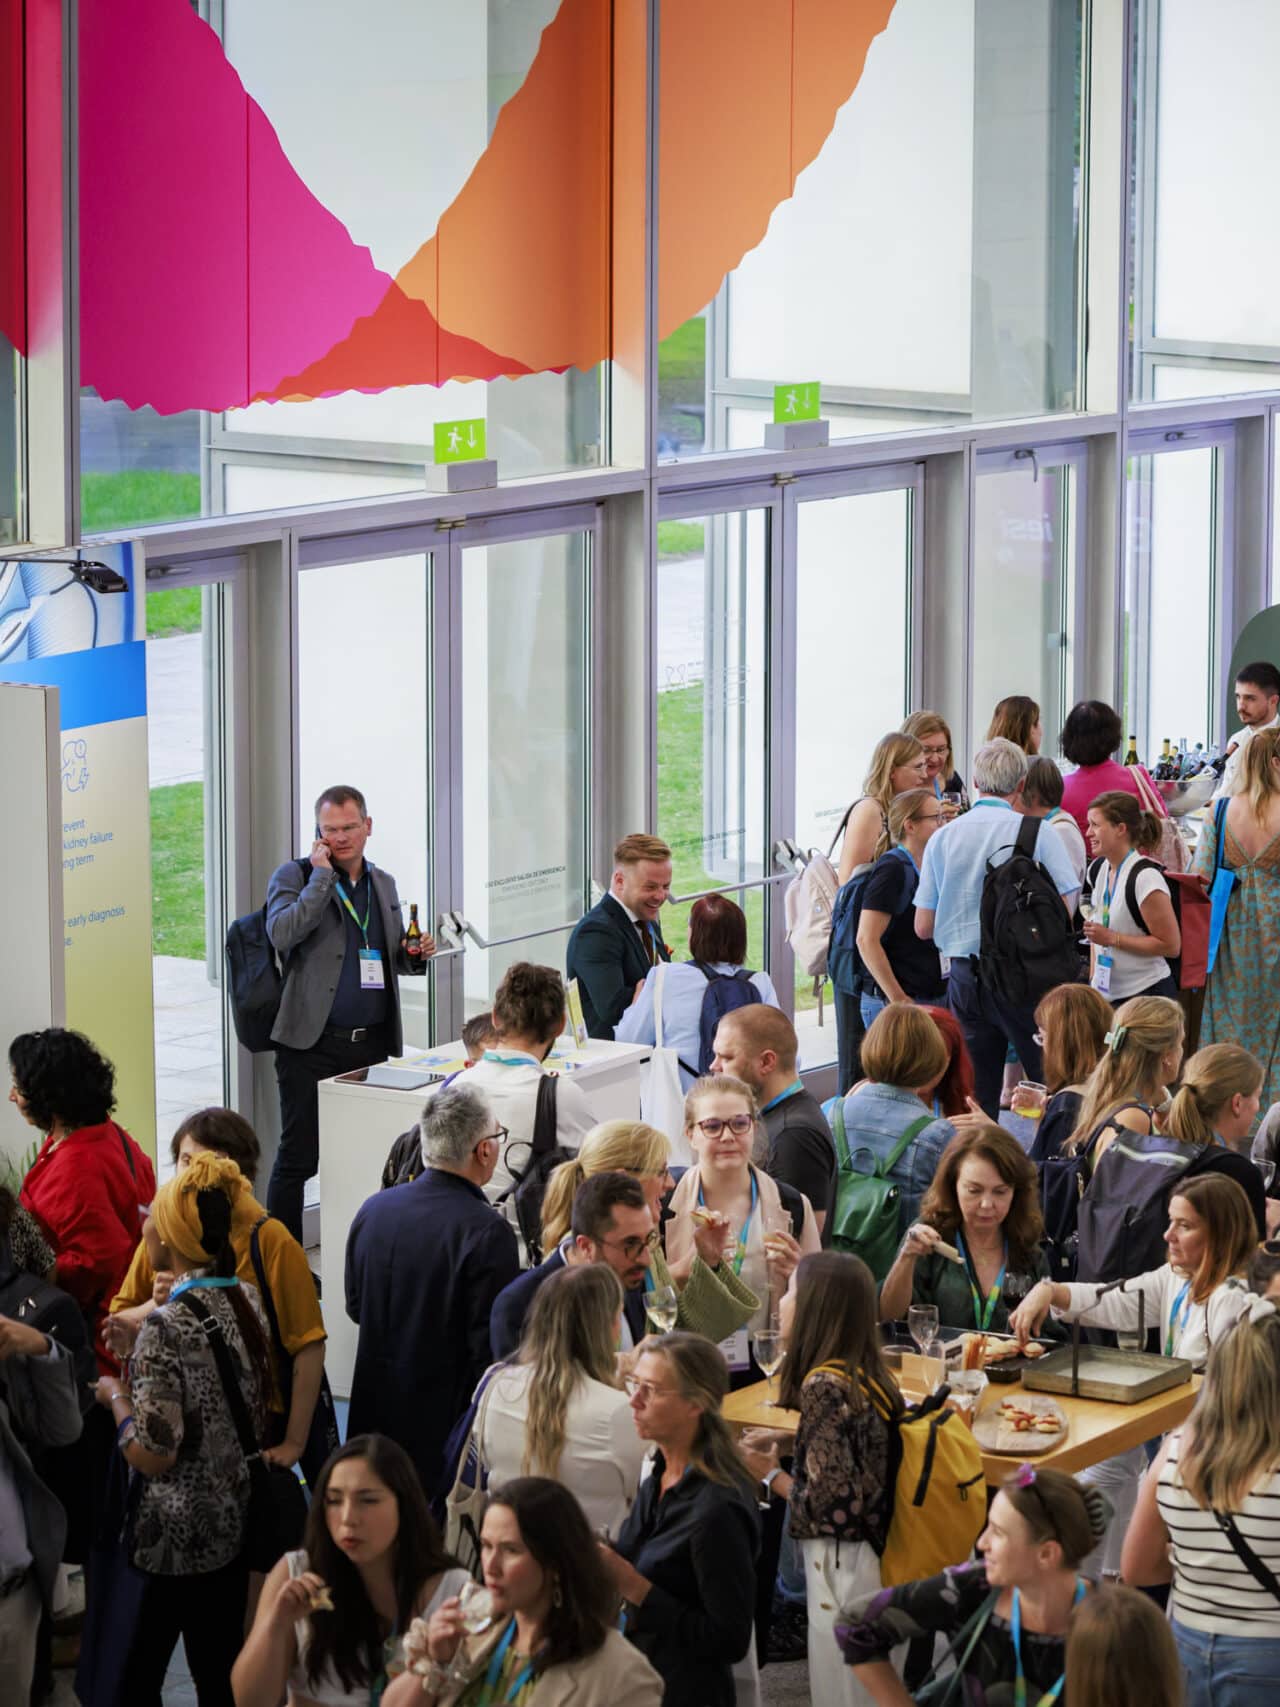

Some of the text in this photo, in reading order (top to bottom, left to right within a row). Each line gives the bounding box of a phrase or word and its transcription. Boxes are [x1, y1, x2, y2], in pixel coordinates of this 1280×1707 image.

[89, 831, 113, 844] failure
[76, 854, 95, 866] term
[67, 906, 126, 928] early diagnosis
